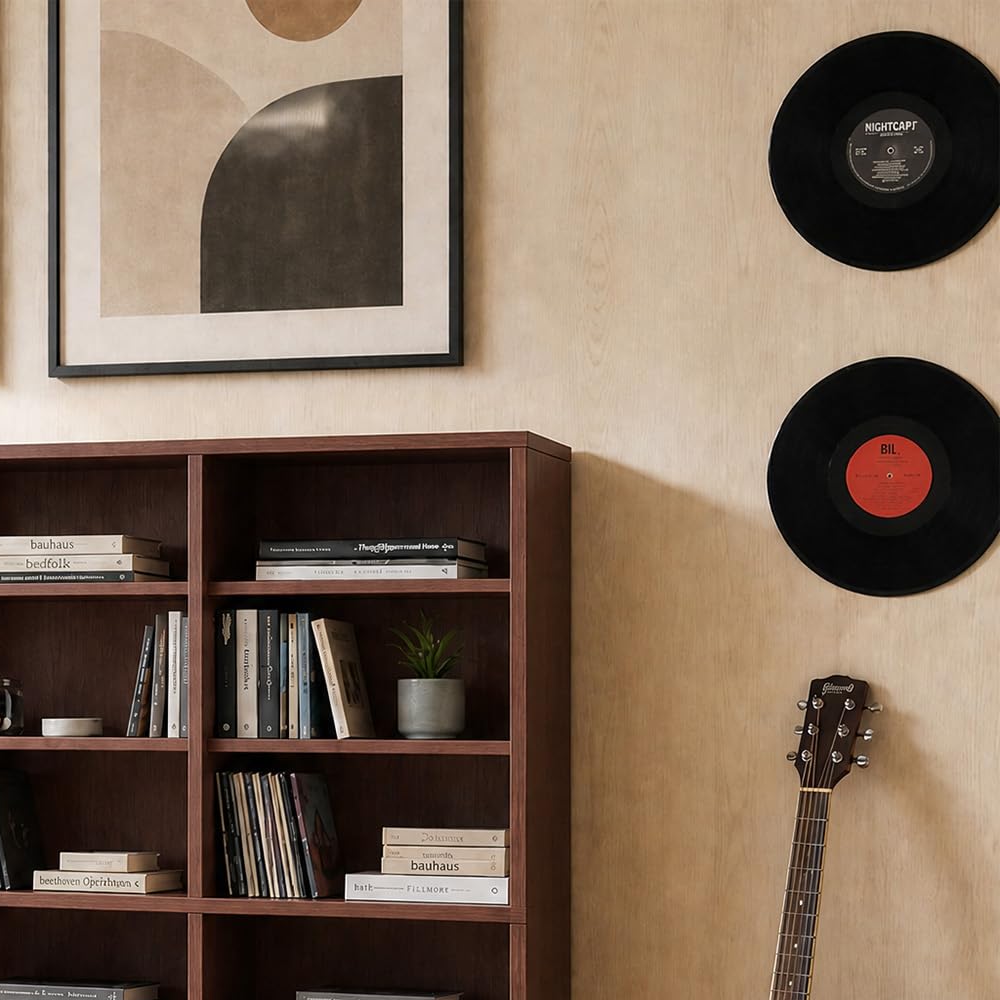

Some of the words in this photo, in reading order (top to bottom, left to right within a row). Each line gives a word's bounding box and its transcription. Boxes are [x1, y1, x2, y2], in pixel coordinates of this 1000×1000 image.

[30, 539, 75, 550] bauhaus
[25, 558, 71, 570] bedfolk
[410, 859, 460, 872] bauhaus
[39, 875, 81, 886] beethoven
